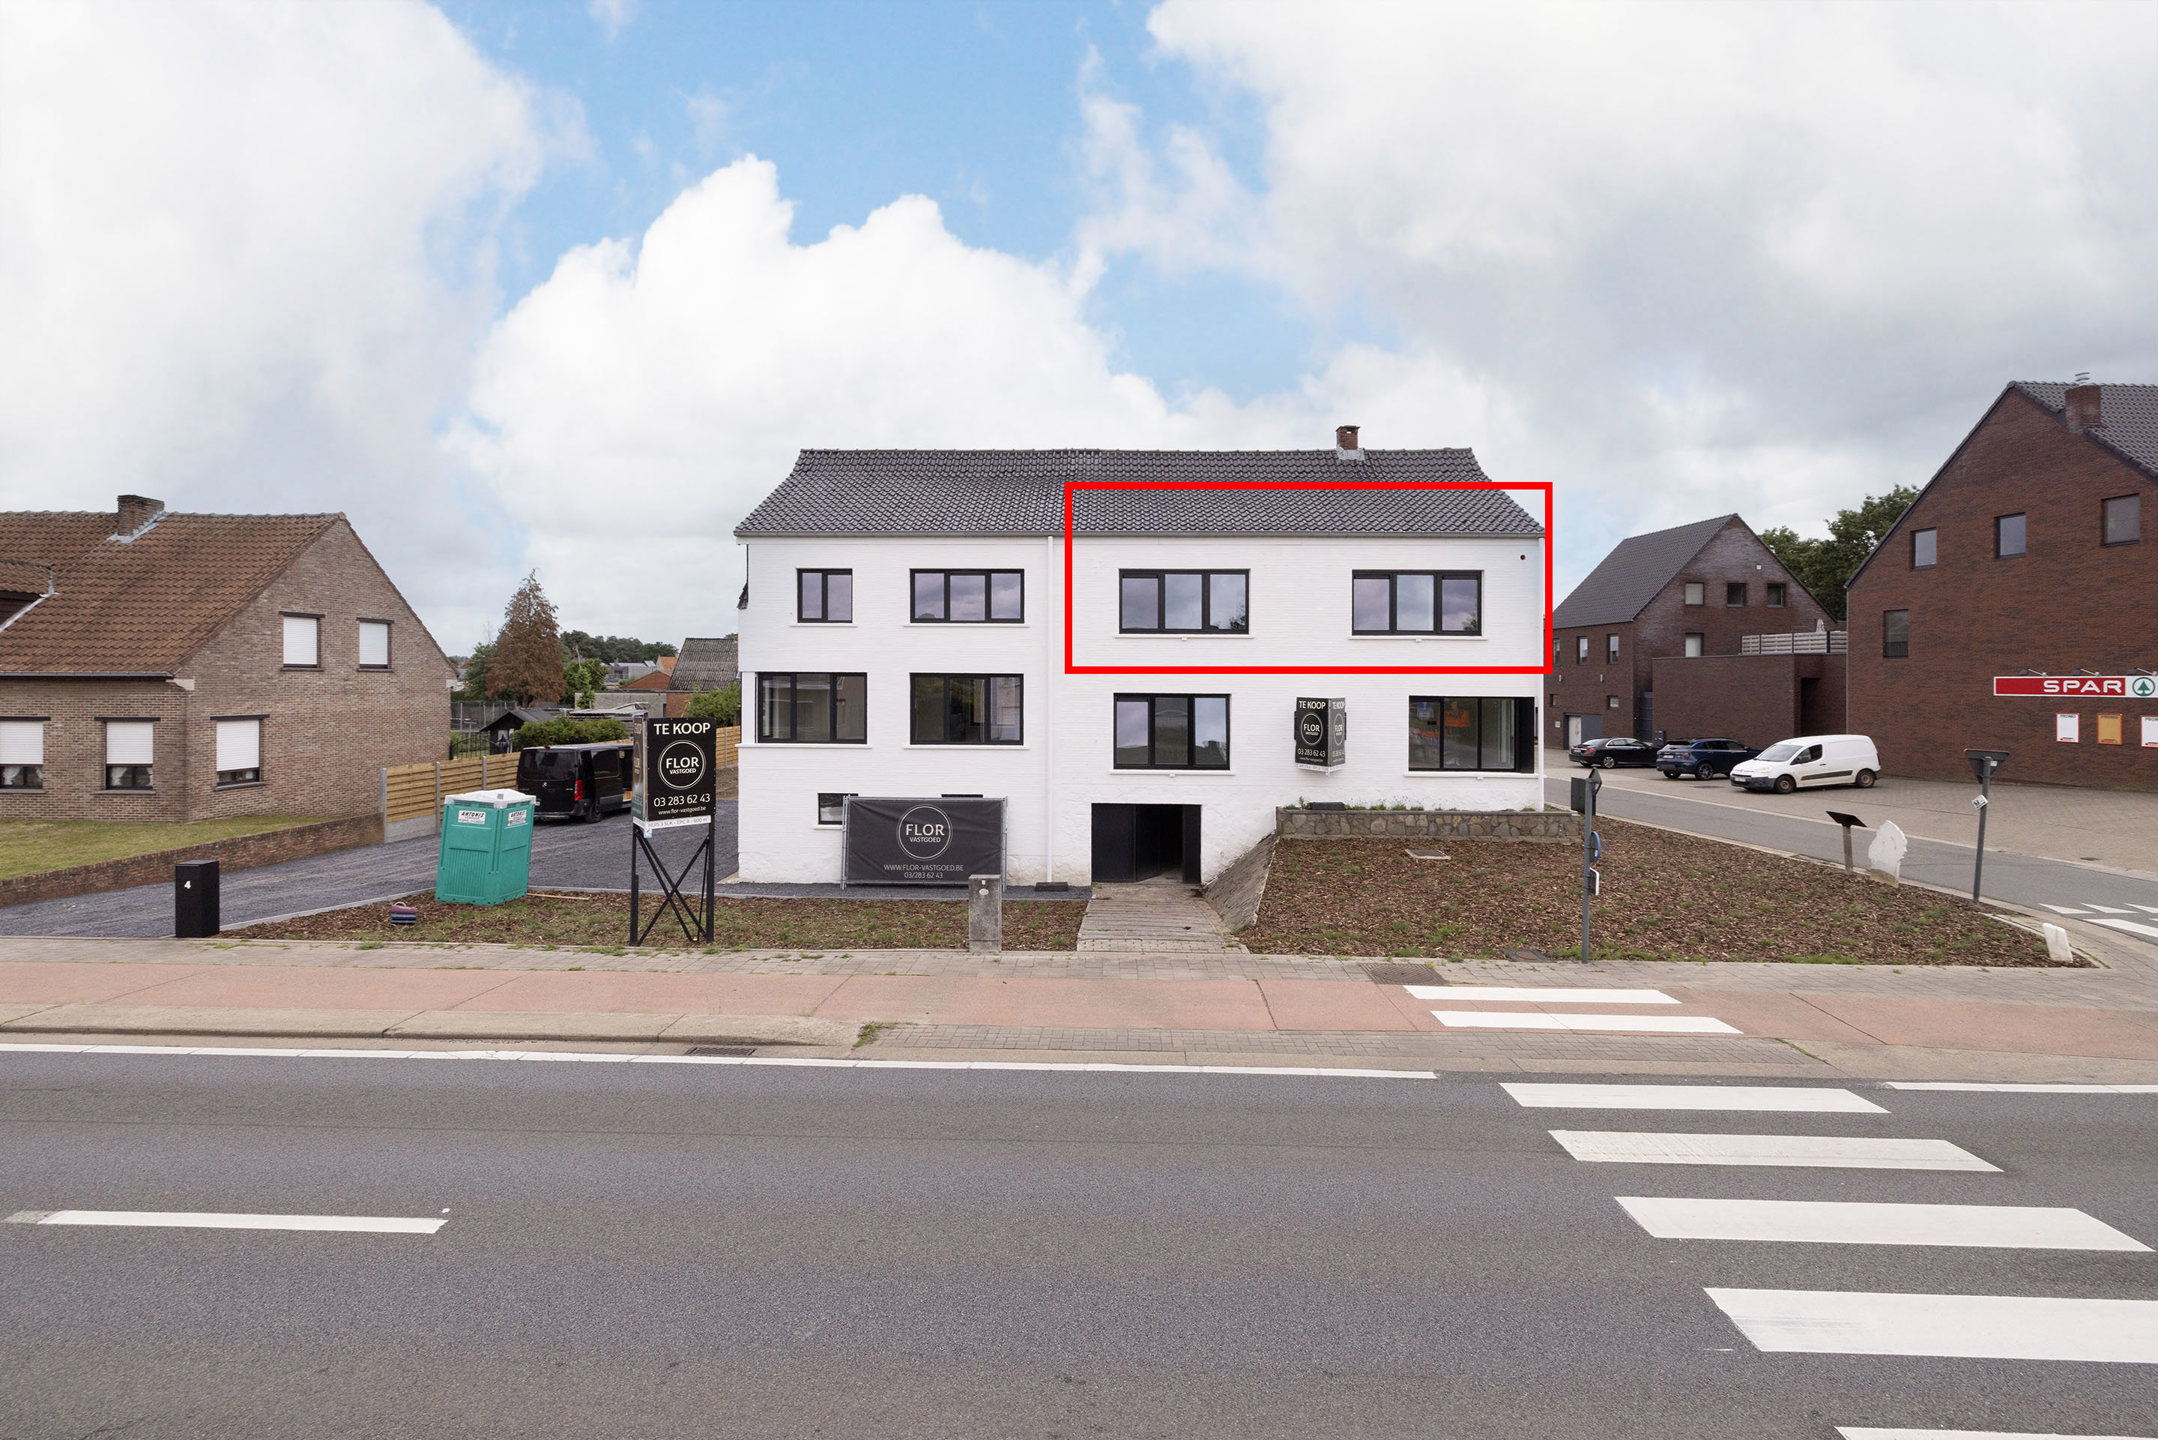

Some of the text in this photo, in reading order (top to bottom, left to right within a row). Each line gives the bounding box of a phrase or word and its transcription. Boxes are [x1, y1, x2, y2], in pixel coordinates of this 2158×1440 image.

[2043, 680, 2122, 693] SPAR
[1299, 701, 1326, 709] TE KOOP
[653, 723, 670, 735] TE
[673, 722, 711, 735] KOOP
[1303, 724, 1320, 732] FLOR
[666, 756, 699, 769] FLOR
[653, 797, 666, 807] 03
[668, 795, 685, 806] 283
[686, 794, 698, 804] 62
[700, 793, 711, 803] 43
[658, 806, 706, 814] www.flor-vastgoed.be
[905, 824, 945, 836] FLOR
[184, 880, 192, 890] 4
